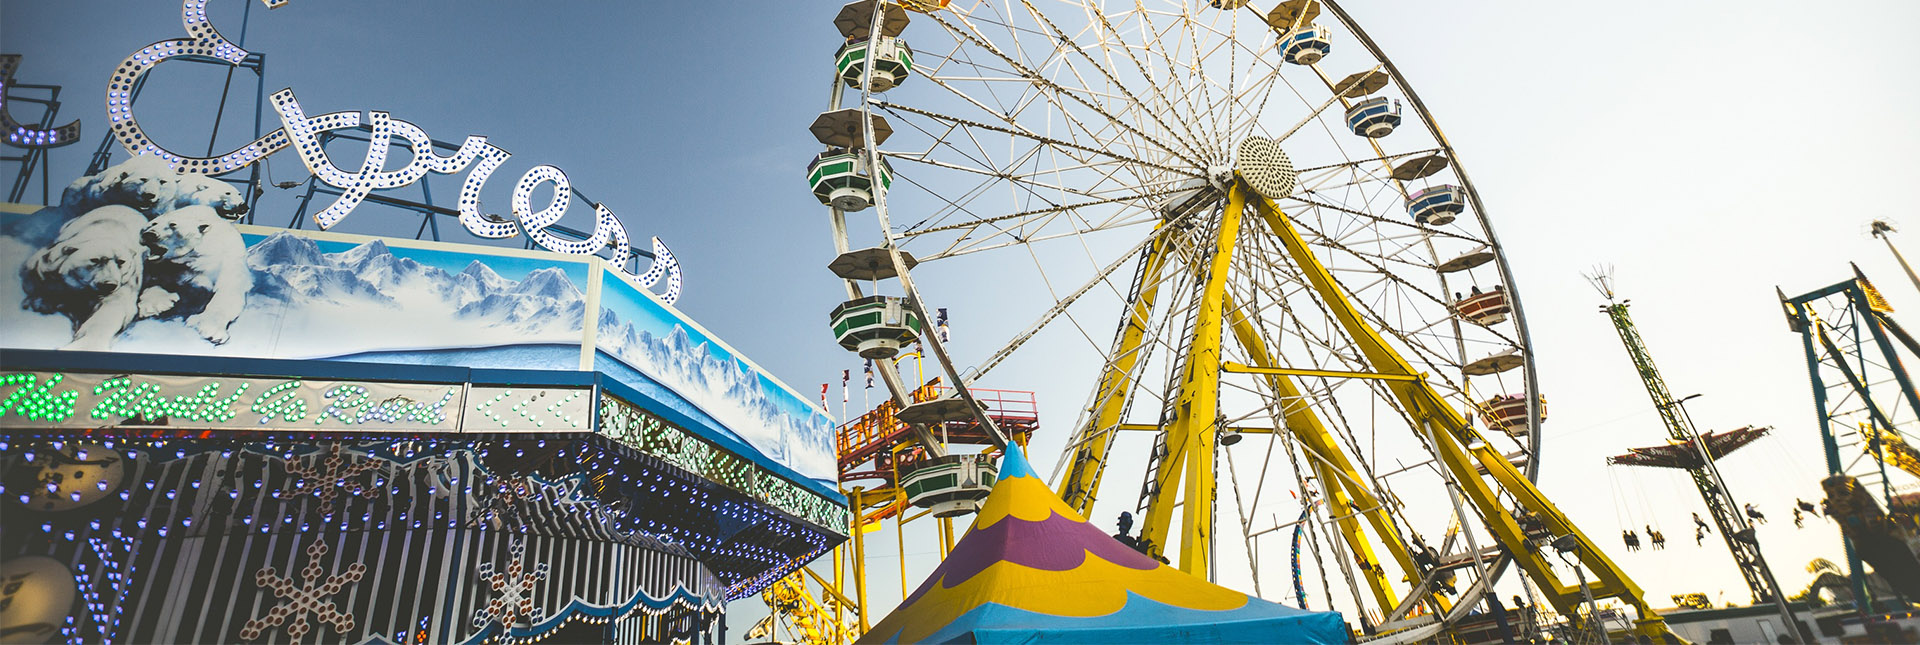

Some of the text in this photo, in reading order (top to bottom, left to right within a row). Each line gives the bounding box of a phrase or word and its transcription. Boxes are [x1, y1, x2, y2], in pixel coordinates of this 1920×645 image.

[106, 0, 683, 306] Express
[90, 377, 250, 422] World
[251, 380, 307, 425] Go
[314, 387, 456, 425] Round
